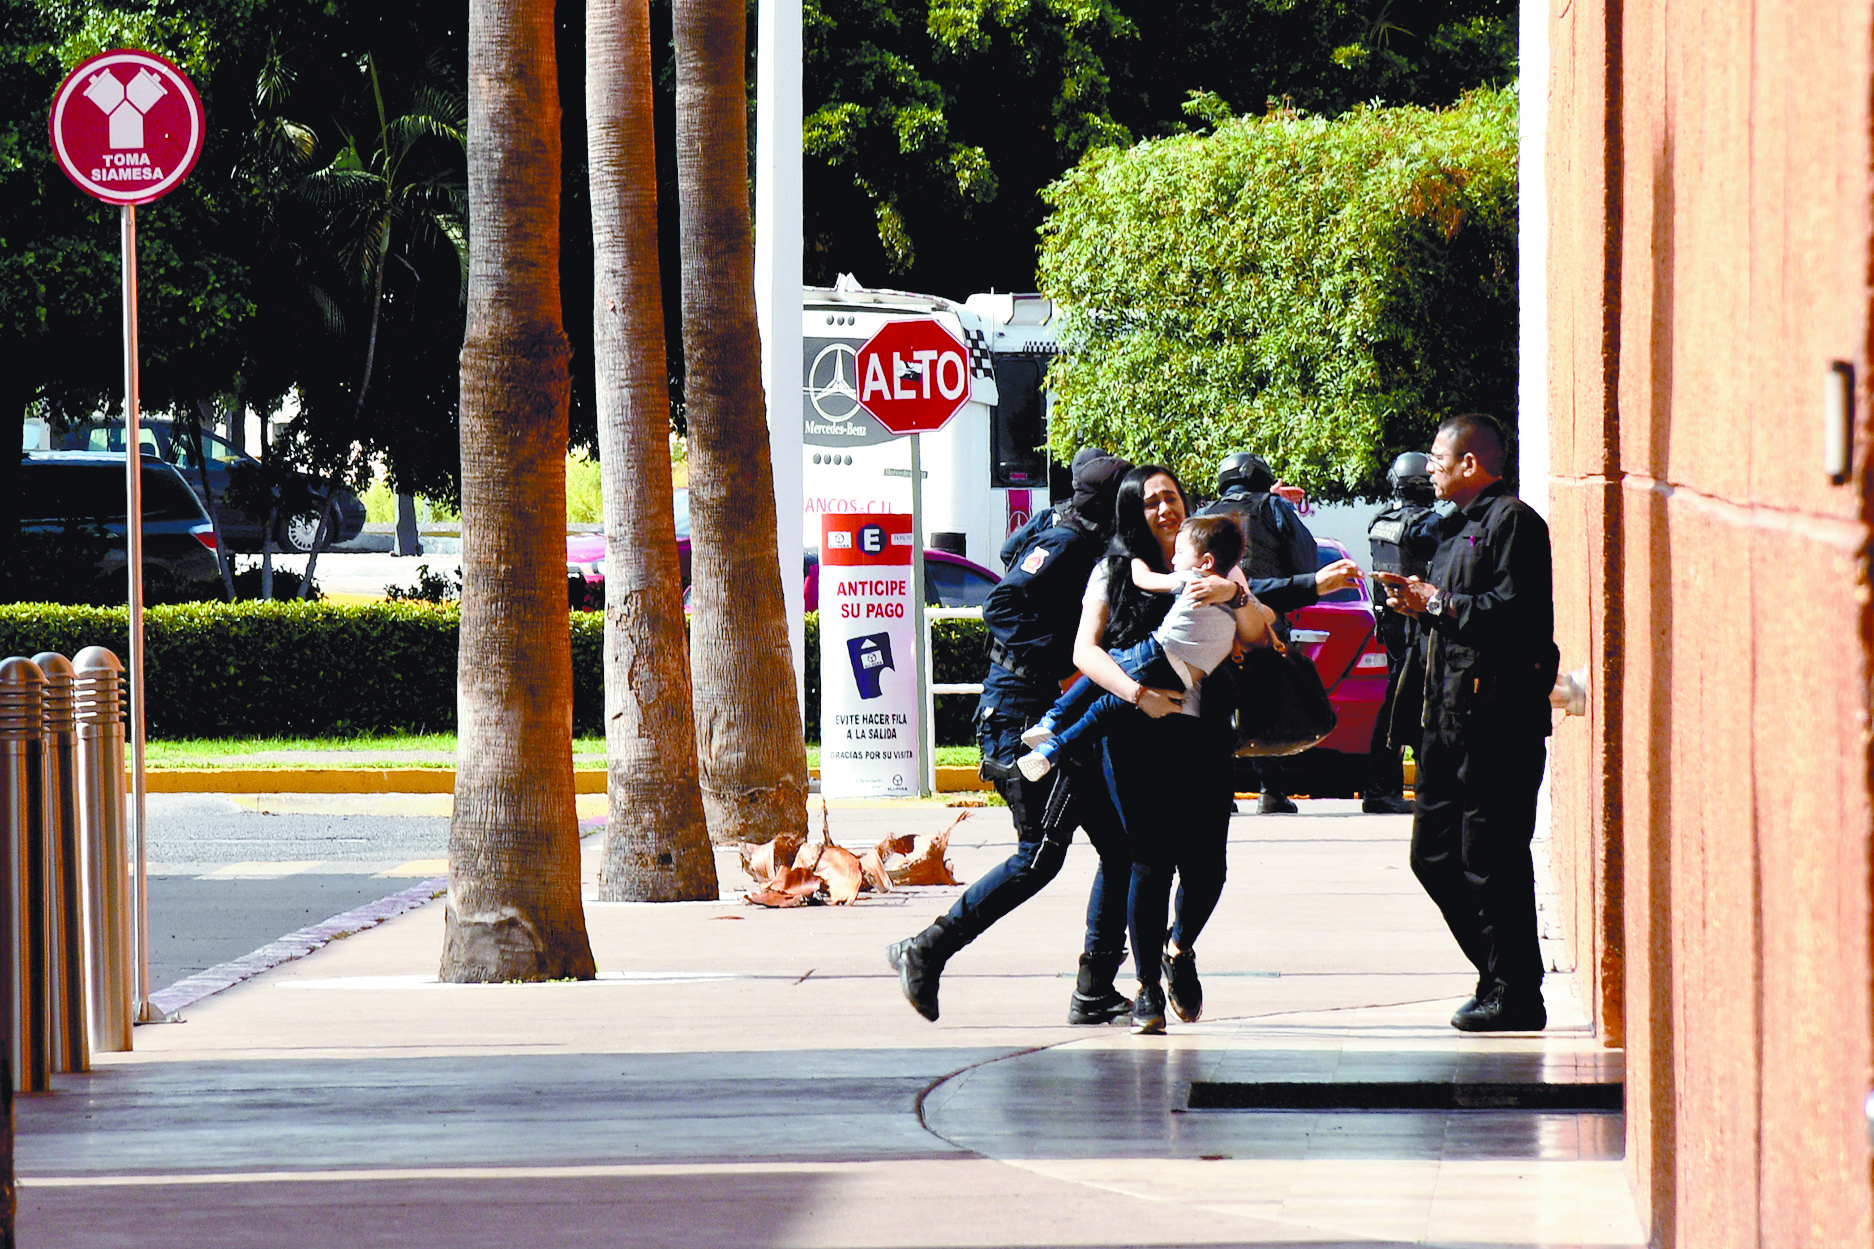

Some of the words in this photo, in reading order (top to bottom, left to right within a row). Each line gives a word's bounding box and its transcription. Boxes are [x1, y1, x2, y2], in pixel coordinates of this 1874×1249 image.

[102, 152, 151, 167] TOMA
[91, 167, 164, 181] SIAMESA
[862, 349, 965, 402] ALTO
[804, 420, 867, 437] Mercedes-Benz
[863, 528, 881, 551] E
[837, 580, 906, 596] ANTICIPE
[841, 603, 860, 618] SU
[866, 602, 904, 618] PAGO
[835, 714, 860, 725] EVITE
[862, 713, 890, 725] HACER
[891, 713, 908, 725] FILA
[846, 728, 853, 739] A
[855, 728, 866, 739] LA
[868, 727, 897, 739] SALIDA
[865, 750, 880, 760] POR
[882, 750, 892, 759] SU
[893, 750, 913, 759] VISITA
